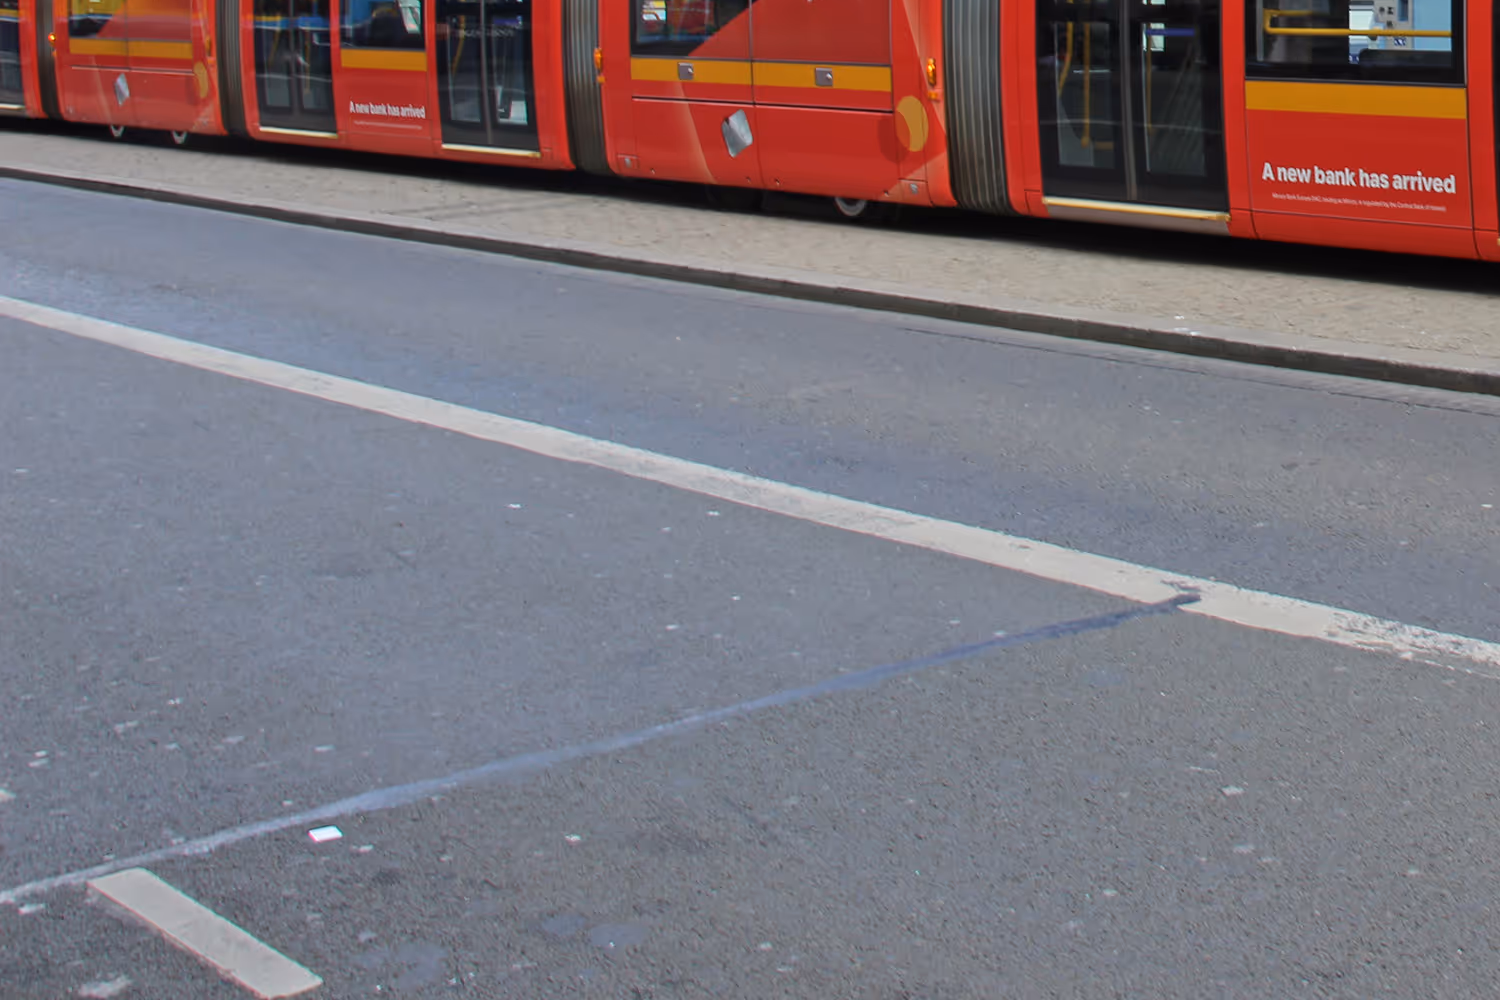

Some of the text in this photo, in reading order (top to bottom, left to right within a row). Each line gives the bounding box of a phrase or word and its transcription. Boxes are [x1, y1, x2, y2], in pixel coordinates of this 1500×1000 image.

[350, 100, 426, 119] A new bank has arrived
[1262, 161, 1457, 194] A new bank has arrived
